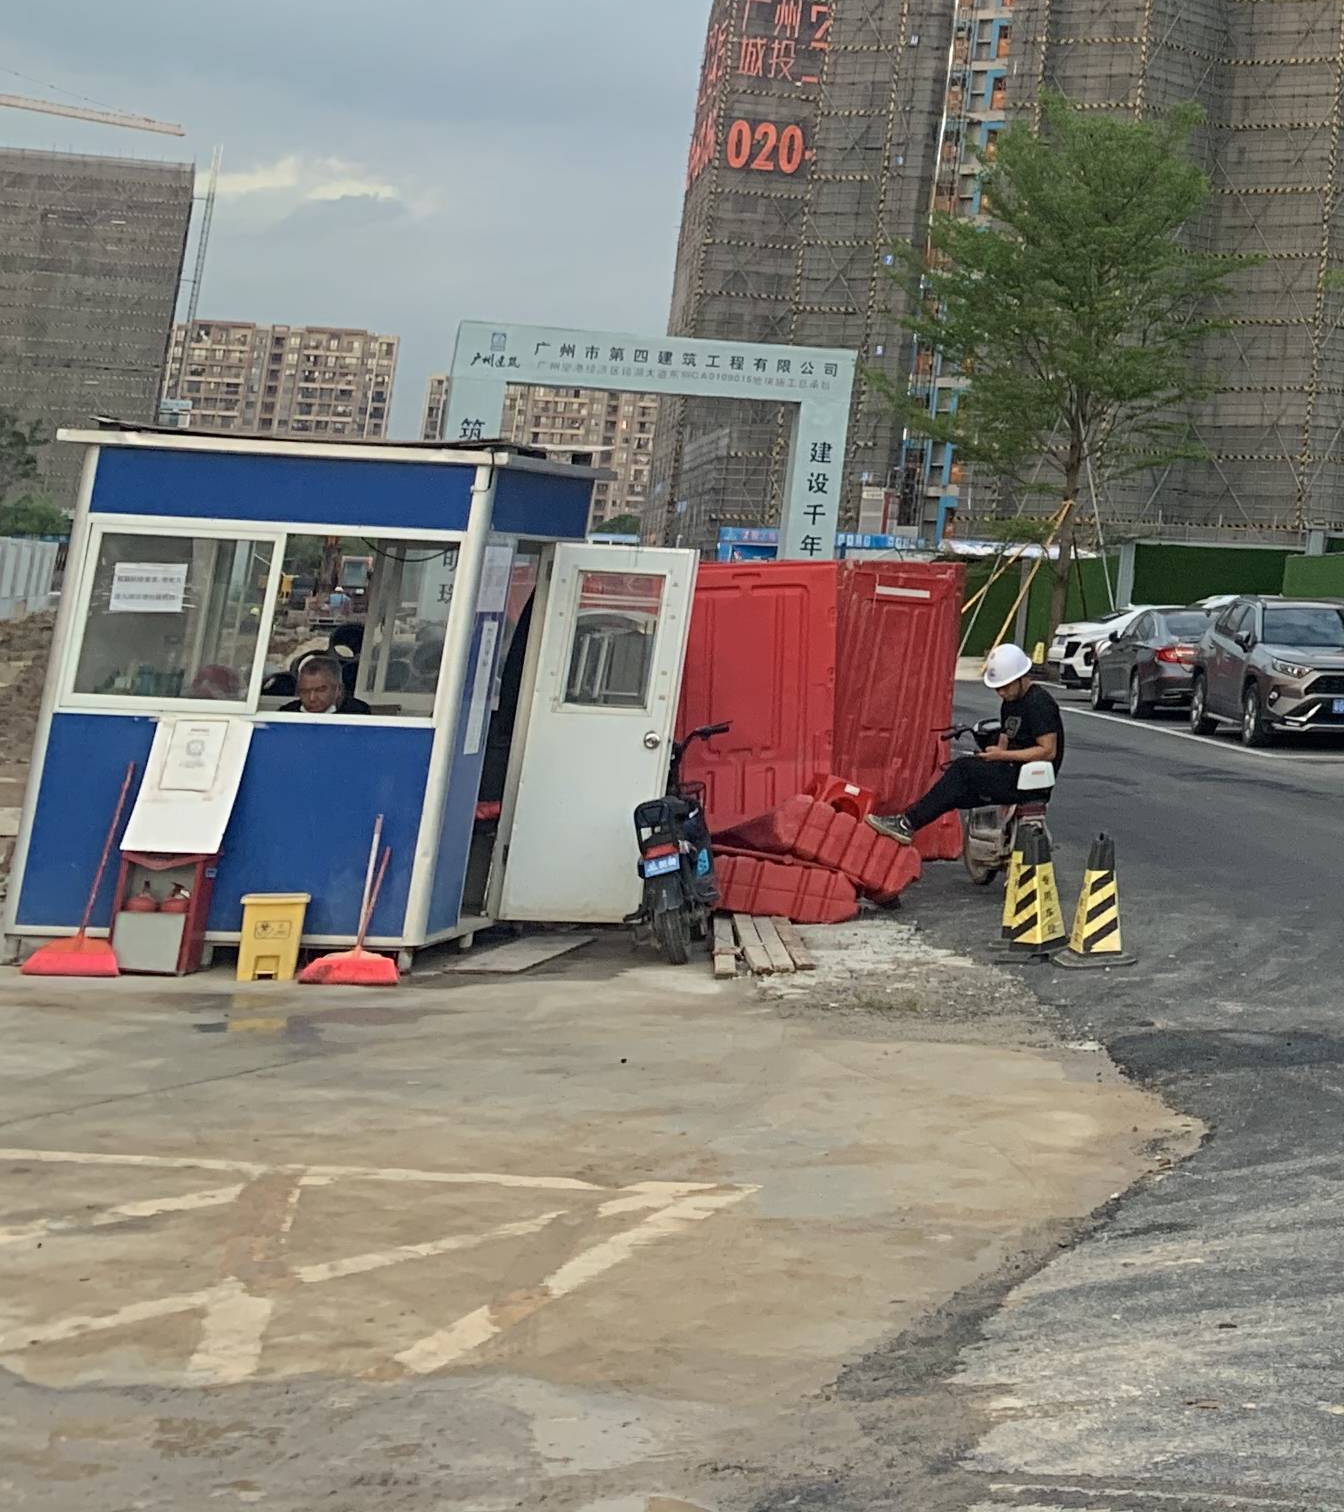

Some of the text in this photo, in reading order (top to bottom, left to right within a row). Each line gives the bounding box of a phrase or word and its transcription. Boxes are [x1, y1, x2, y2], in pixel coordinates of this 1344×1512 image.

[736, 37, 796, 82] 城投
[470, 351, 521, 369] 广州建筑
[534, 341, 839, 378] 广州市第四建筑工程有限公司
[800, 441, 833, 557] 建设千年
